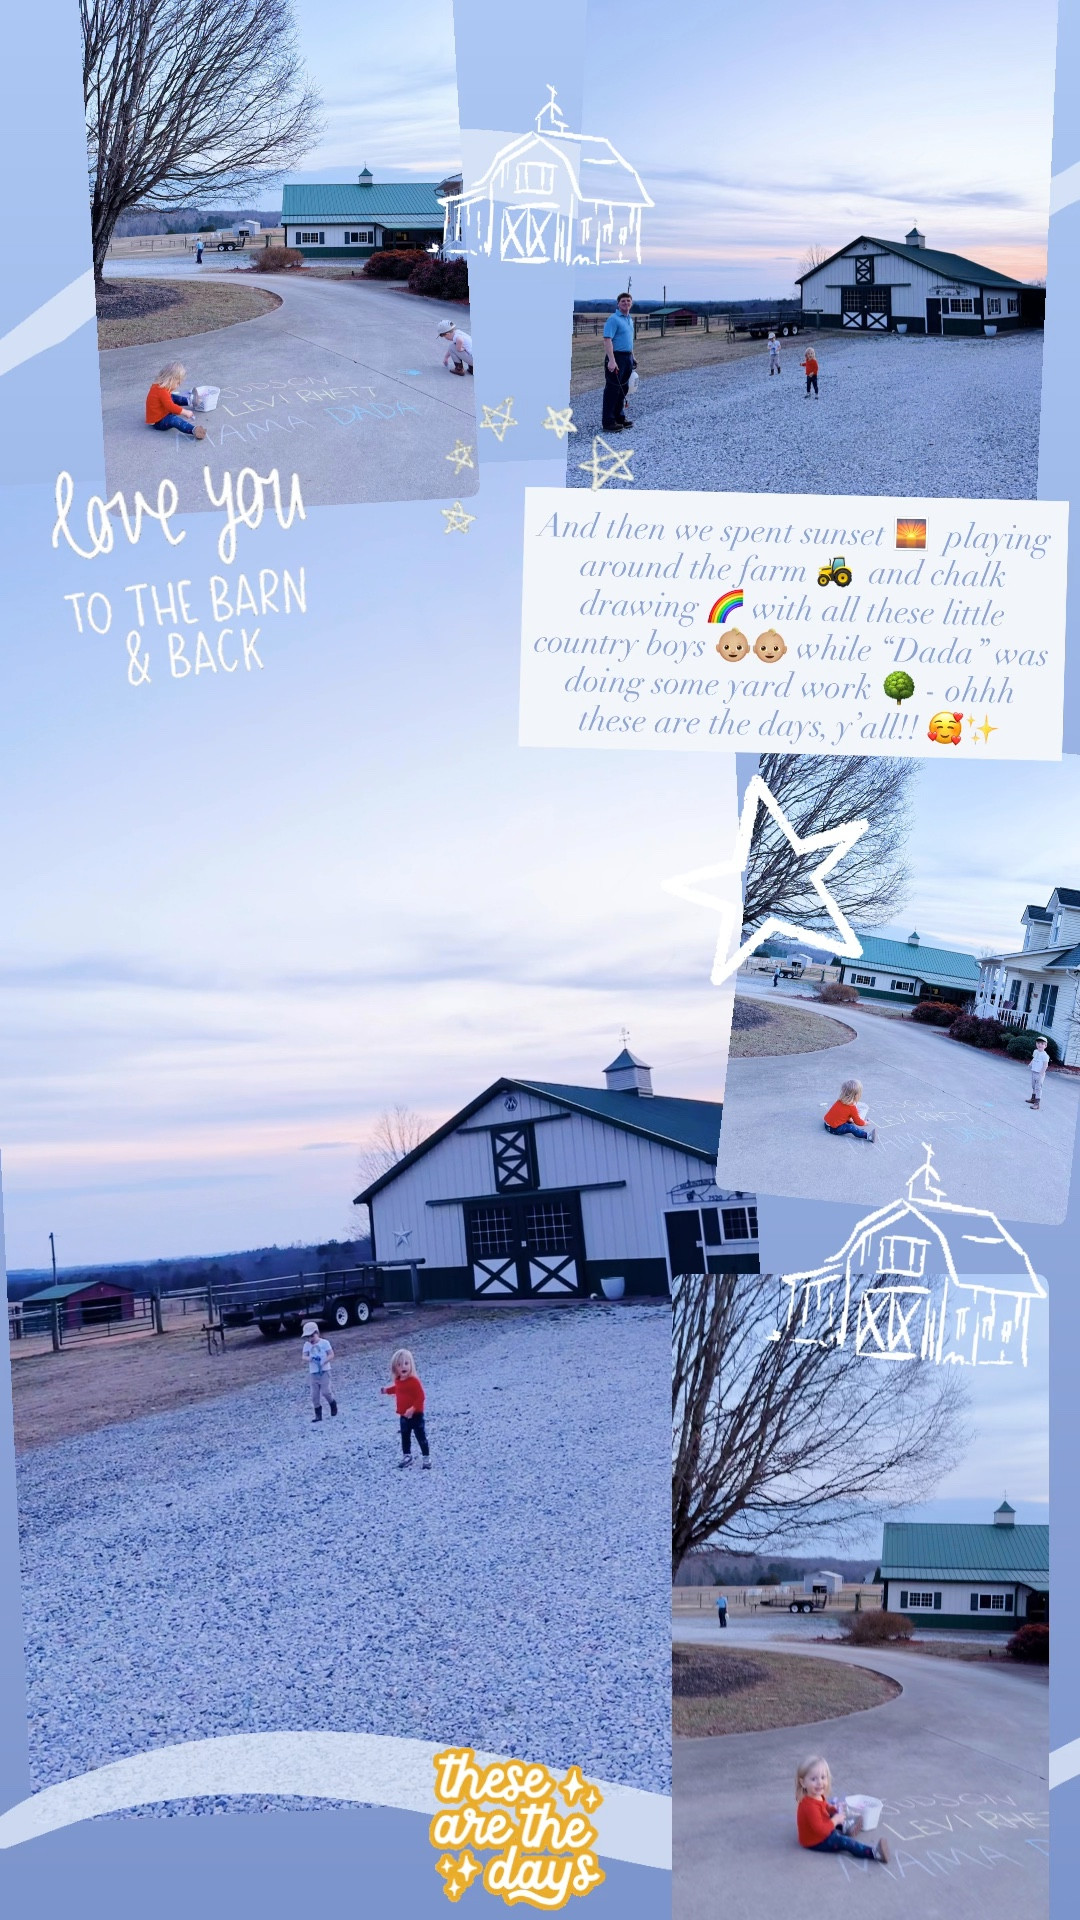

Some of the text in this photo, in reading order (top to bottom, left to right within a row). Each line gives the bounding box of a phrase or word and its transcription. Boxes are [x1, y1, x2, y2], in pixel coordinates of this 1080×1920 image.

[222, 386, 377, 418] LEVI RHETT
[324, 400, 423, 426] DADA
[882, 1814, 974, 1841] LEVI
